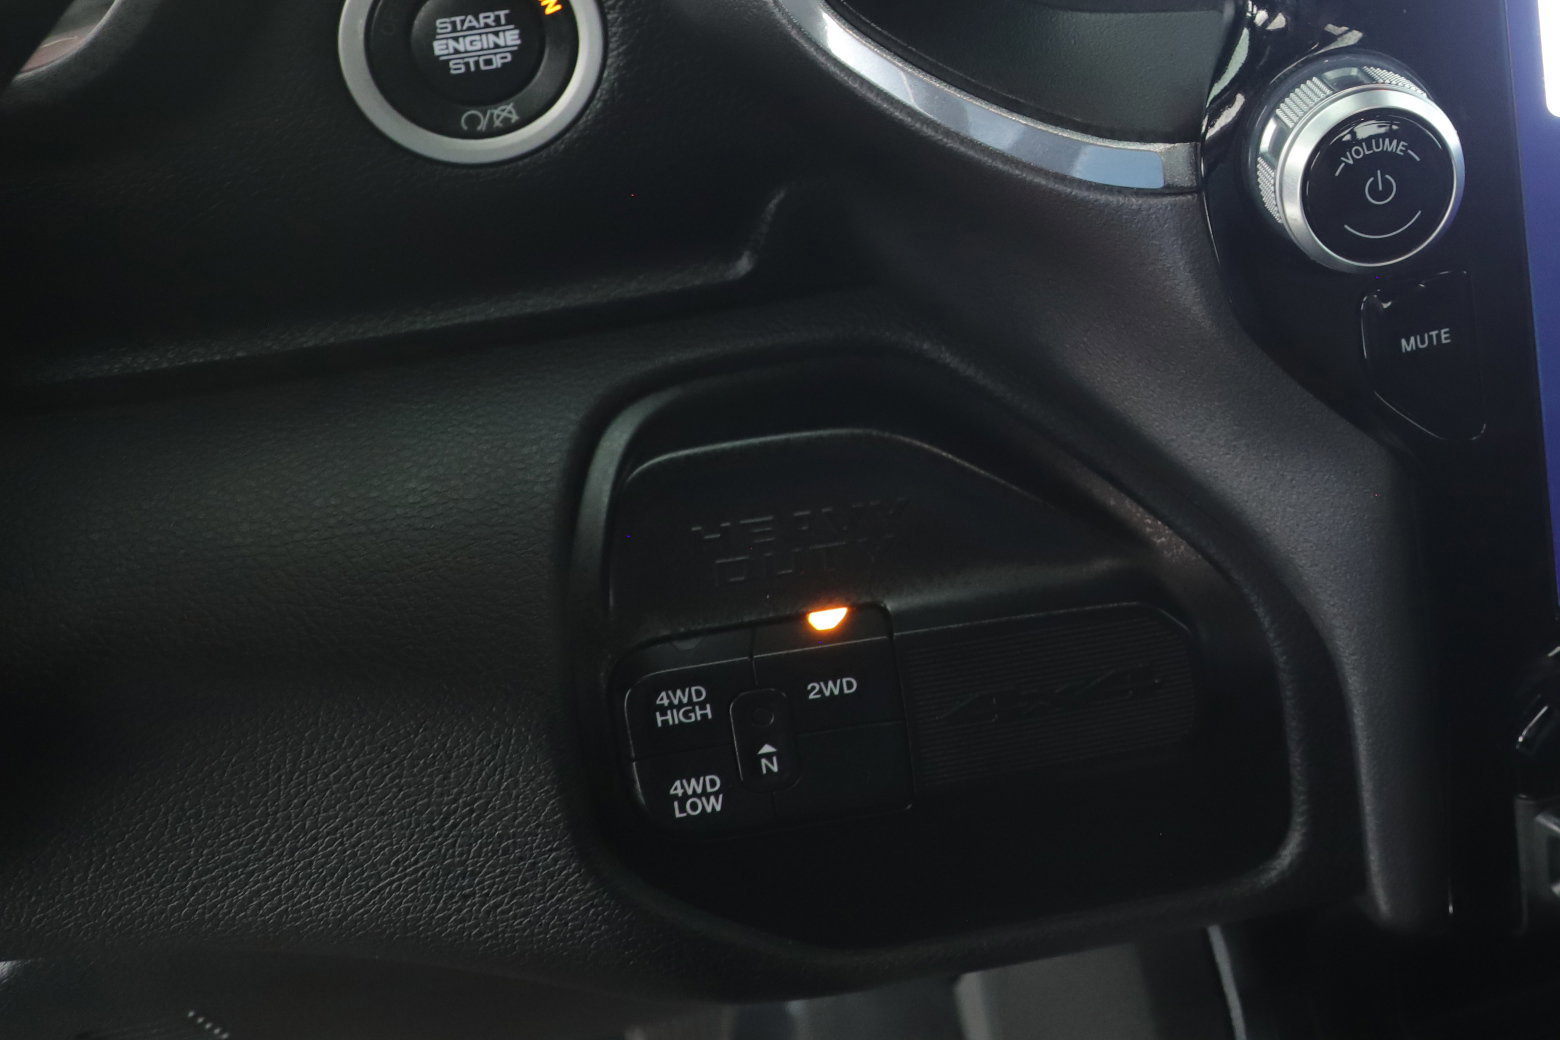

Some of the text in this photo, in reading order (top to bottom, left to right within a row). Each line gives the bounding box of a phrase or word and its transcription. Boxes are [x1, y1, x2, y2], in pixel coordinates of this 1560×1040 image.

[435, 9, 512, 34] START
[432, 30, 522, 57] ENGINE
[449, 51, 513, 75] STOP
[1340, 137, 1408, 167] VOLUME
[1401, 327, 1451, 353] MUTE
[655, 685, 707, 708] 4WD
[806, 676, 857, 700] 2WD
[655, 703, 712, 728] HIGH
[761, 754, 779, 775] N
[669, 773, 722, 798] 4WD
[673, 793, 724, 819] LOW
